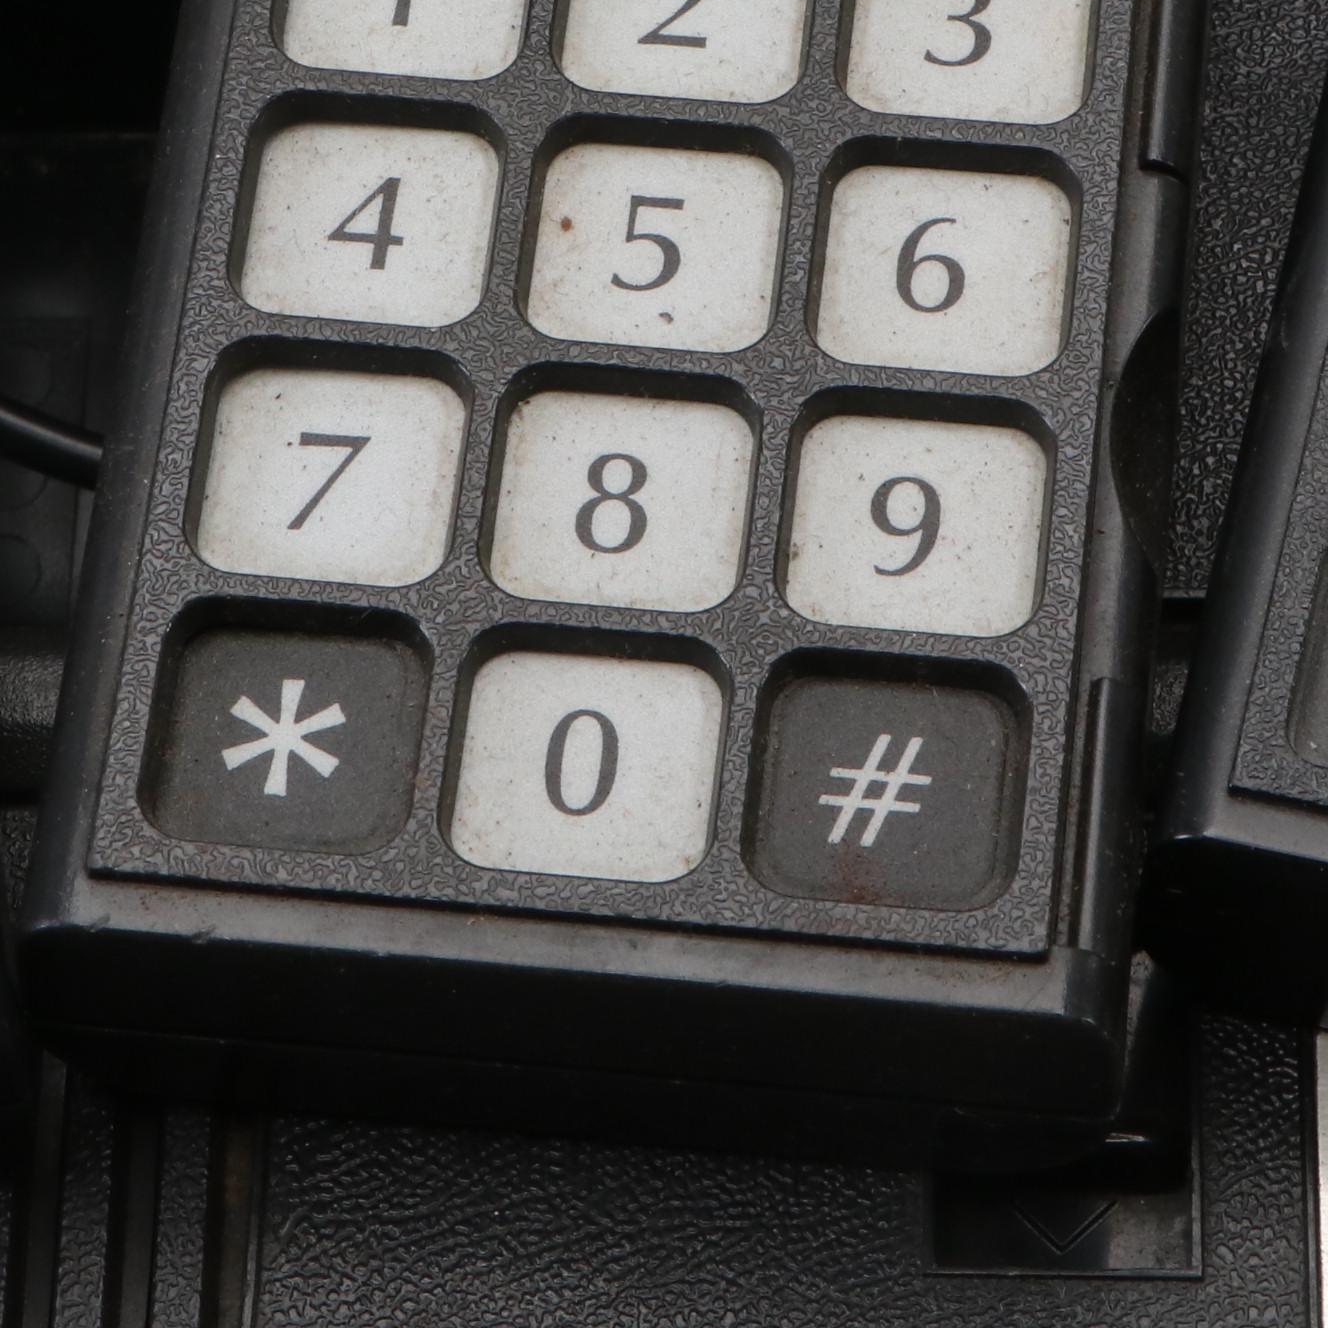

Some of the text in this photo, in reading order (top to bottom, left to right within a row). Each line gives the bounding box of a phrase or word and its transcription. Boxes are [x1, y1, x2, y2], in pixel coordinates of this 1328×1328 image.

[328, 177, 965, 313] 4 5 6
[288, 432, 941, 576] 7 8 9
[545, 709, 618, 816] 0
